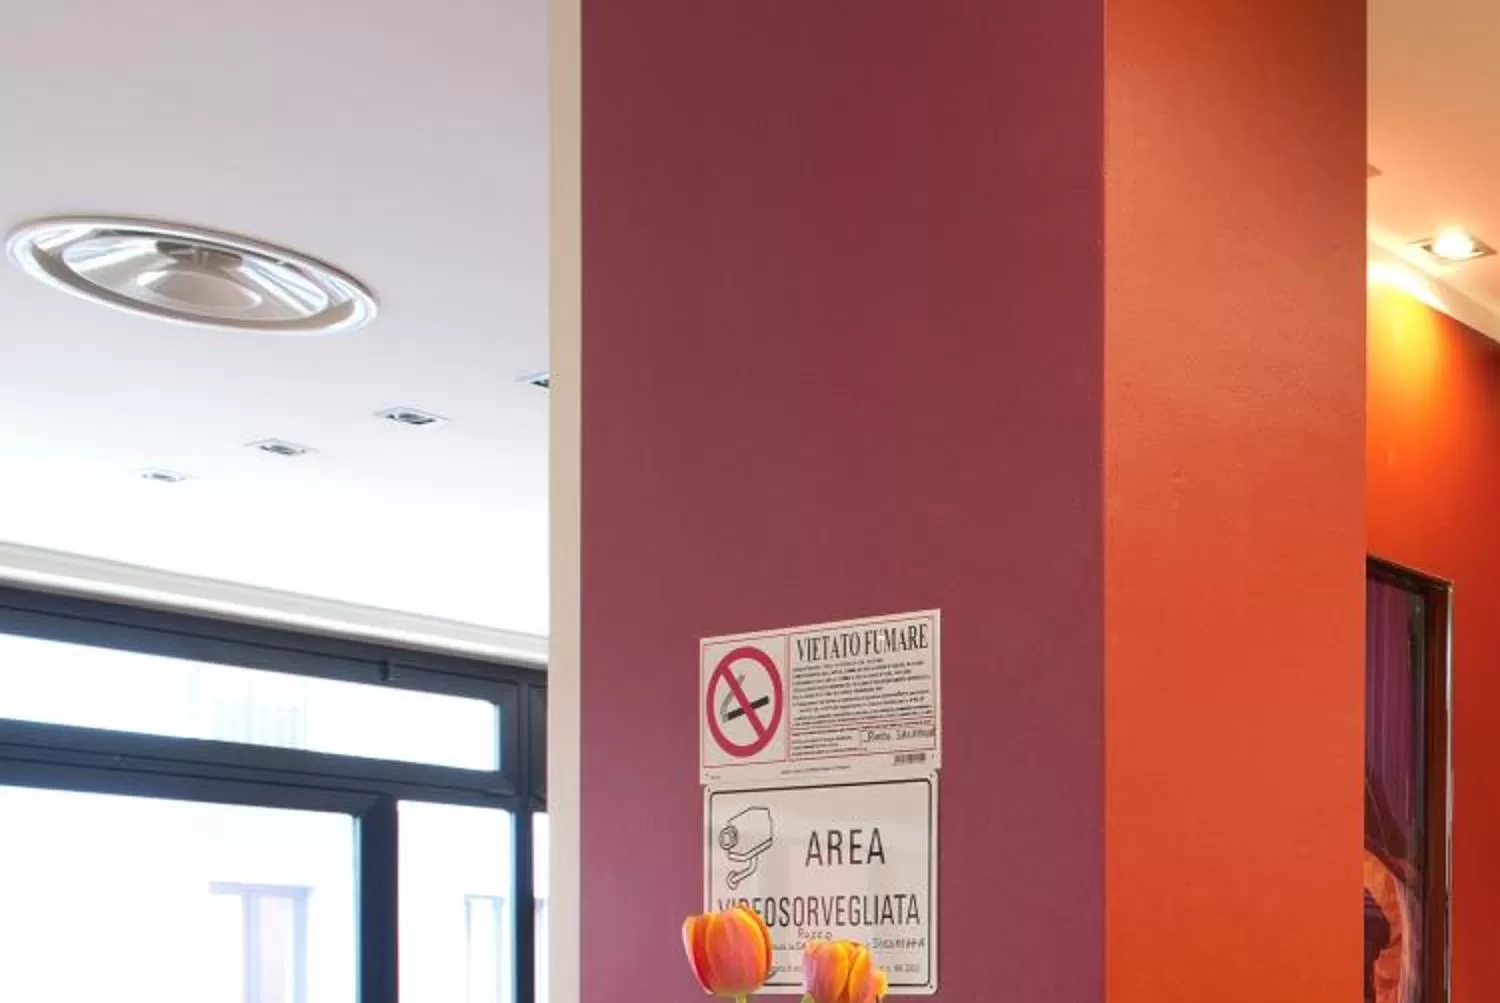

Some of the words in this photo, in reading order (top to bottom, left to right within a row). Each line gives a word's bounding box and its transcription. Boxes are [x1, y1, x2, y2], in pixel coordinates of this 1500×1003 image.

[797, 631, 861, 662] VIETATO
[864, 623, 928, 655] FUMARE
[805, 827, 886, 867] AREA
